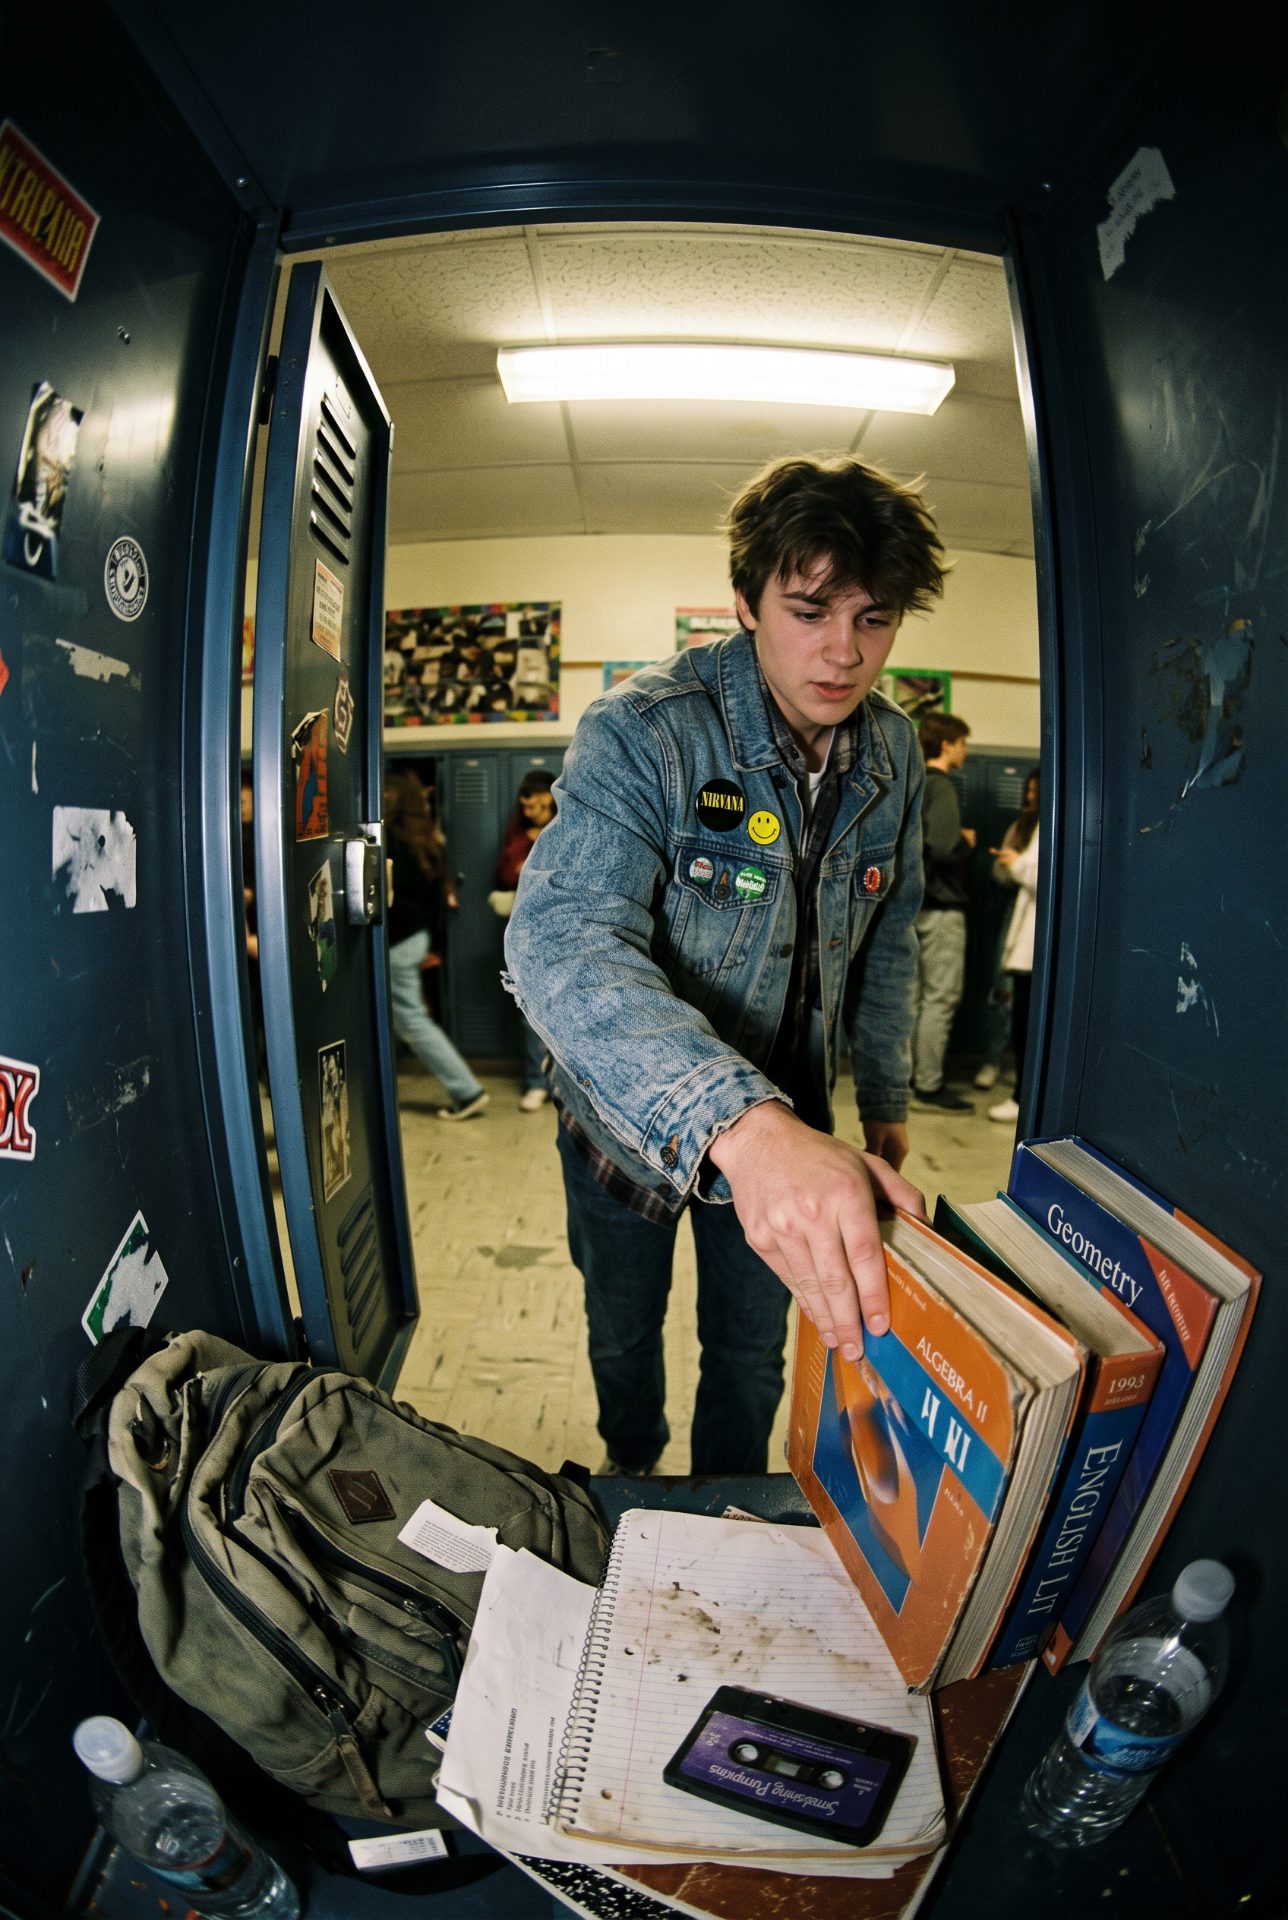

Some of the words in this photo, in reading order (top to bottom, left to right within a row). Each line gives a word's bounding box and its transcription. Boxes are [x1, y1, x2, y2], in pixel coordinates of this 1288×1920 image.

[701, 791, 744, 812] NIRVANA
[1047, 1203, 1143, 1308] Geometry
[916, 1336, 974, 1411] ALGEBRA
[976, 1400, 988, 1424] II
[1109, 1375, 1145, 1394] 1993
[1047, 1438, 1124, 1569] ENGLISH
[1027, 1571, 1070, 1616] LIT
[708, 1763, 772, 1796] Pumpkins
